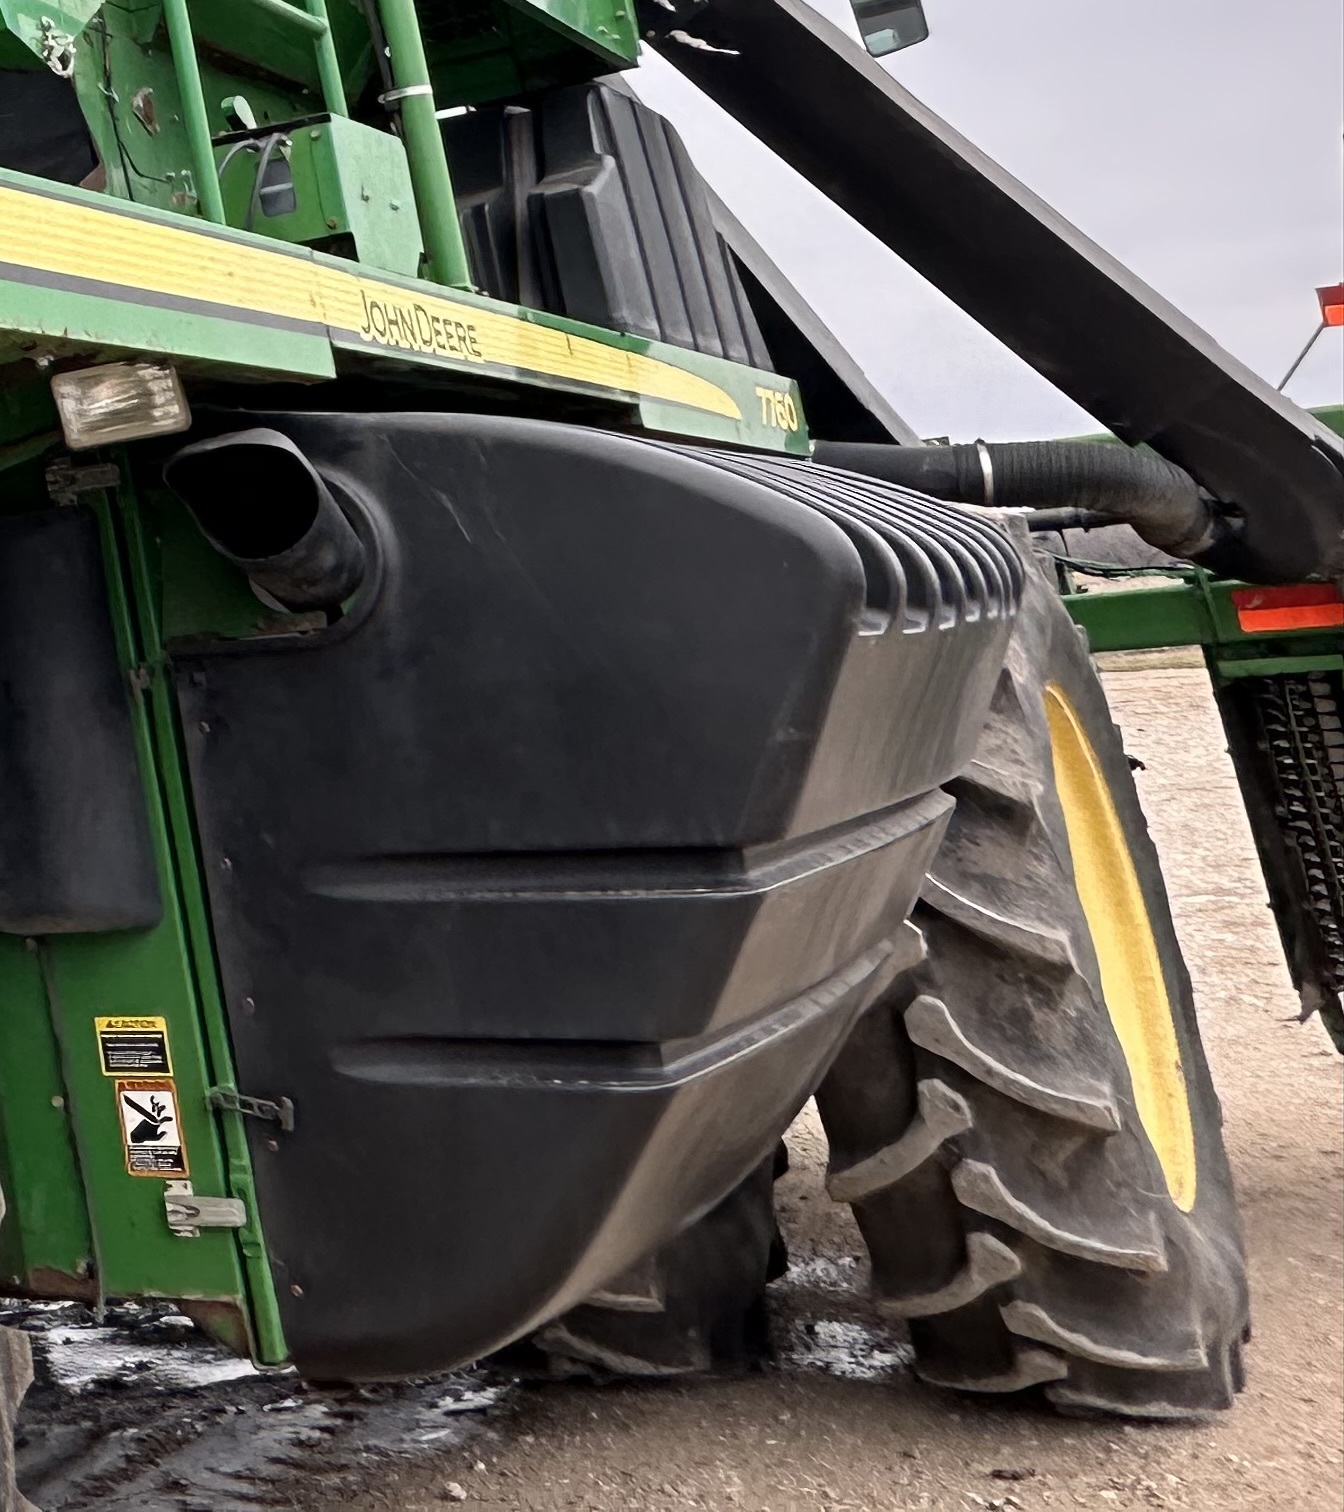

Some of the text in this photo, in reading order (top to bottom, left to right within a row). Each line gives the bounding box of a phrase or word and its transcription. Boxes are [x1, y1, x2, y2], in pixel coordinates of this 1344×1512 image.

[360, 289, 482, 358] JOHN DEERE
[755, 386, 798, 432] 7760
